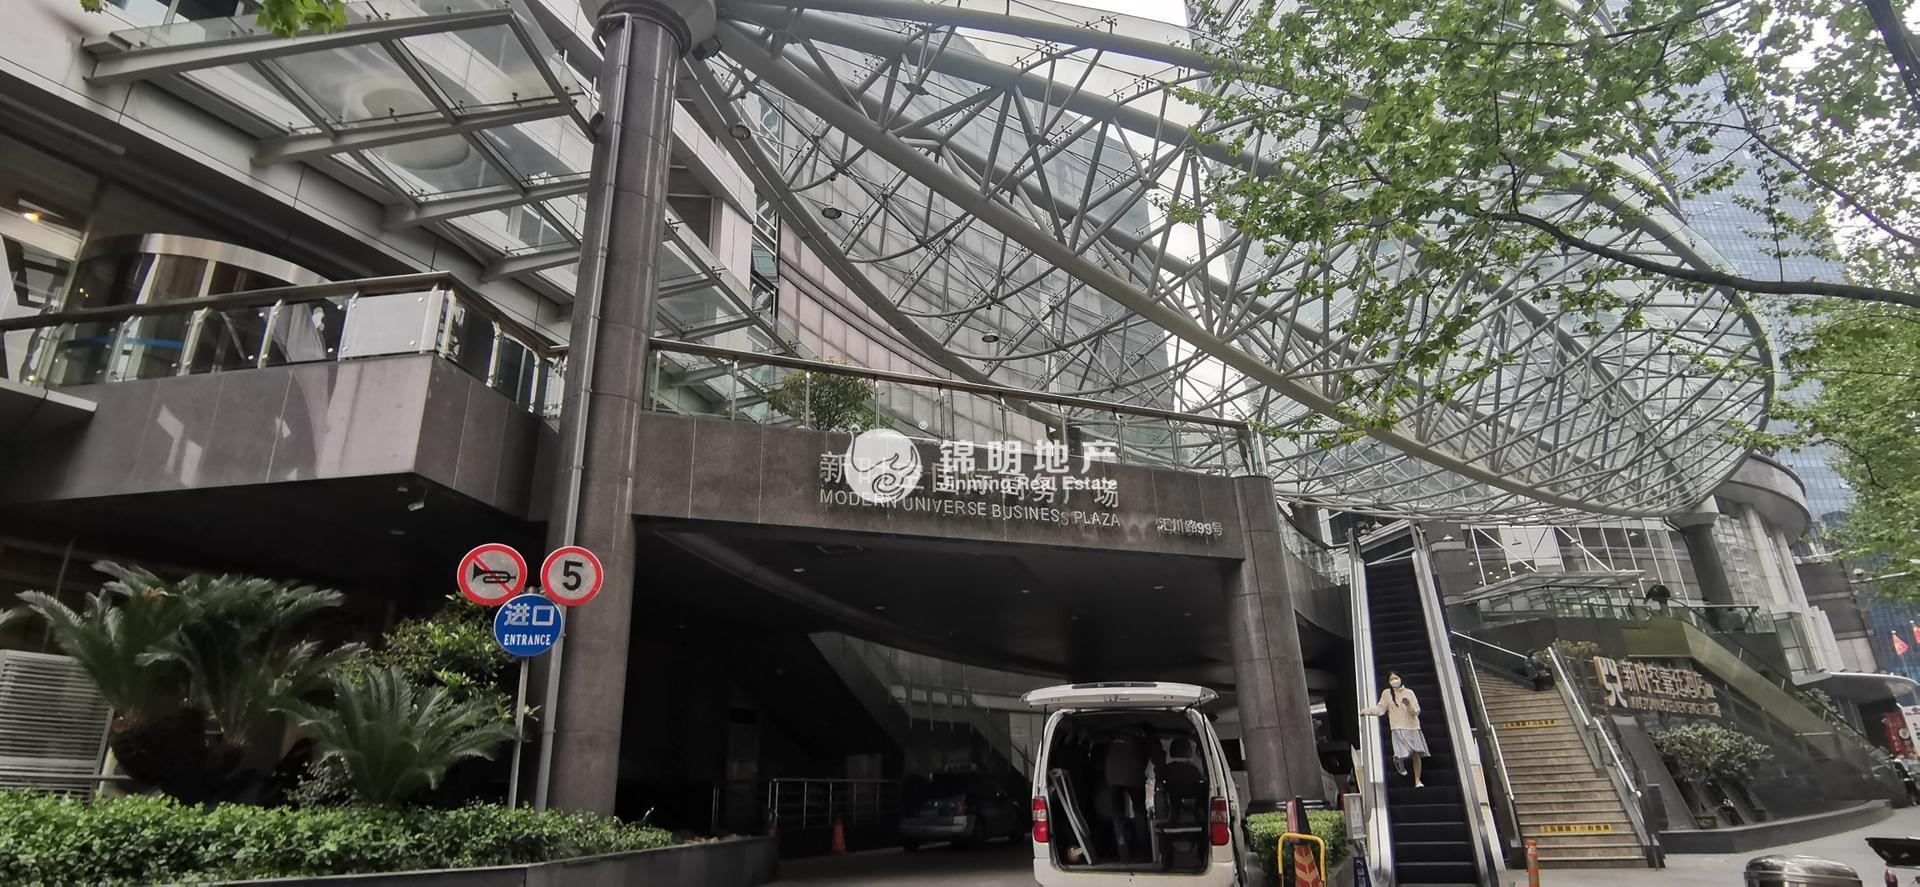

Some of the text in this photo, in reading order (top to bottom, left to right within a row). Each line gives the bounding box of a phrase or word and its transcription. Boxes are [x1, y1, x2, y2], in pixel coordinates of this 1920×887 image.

[819, 488, 1121, 527] MODERN UNIVERSE BUSINESS PLAZA
[562, 560, 583, 591] 5
[504, 603, 554, 626] 进口
[503, 634, 551, 646] ENTRANCE
